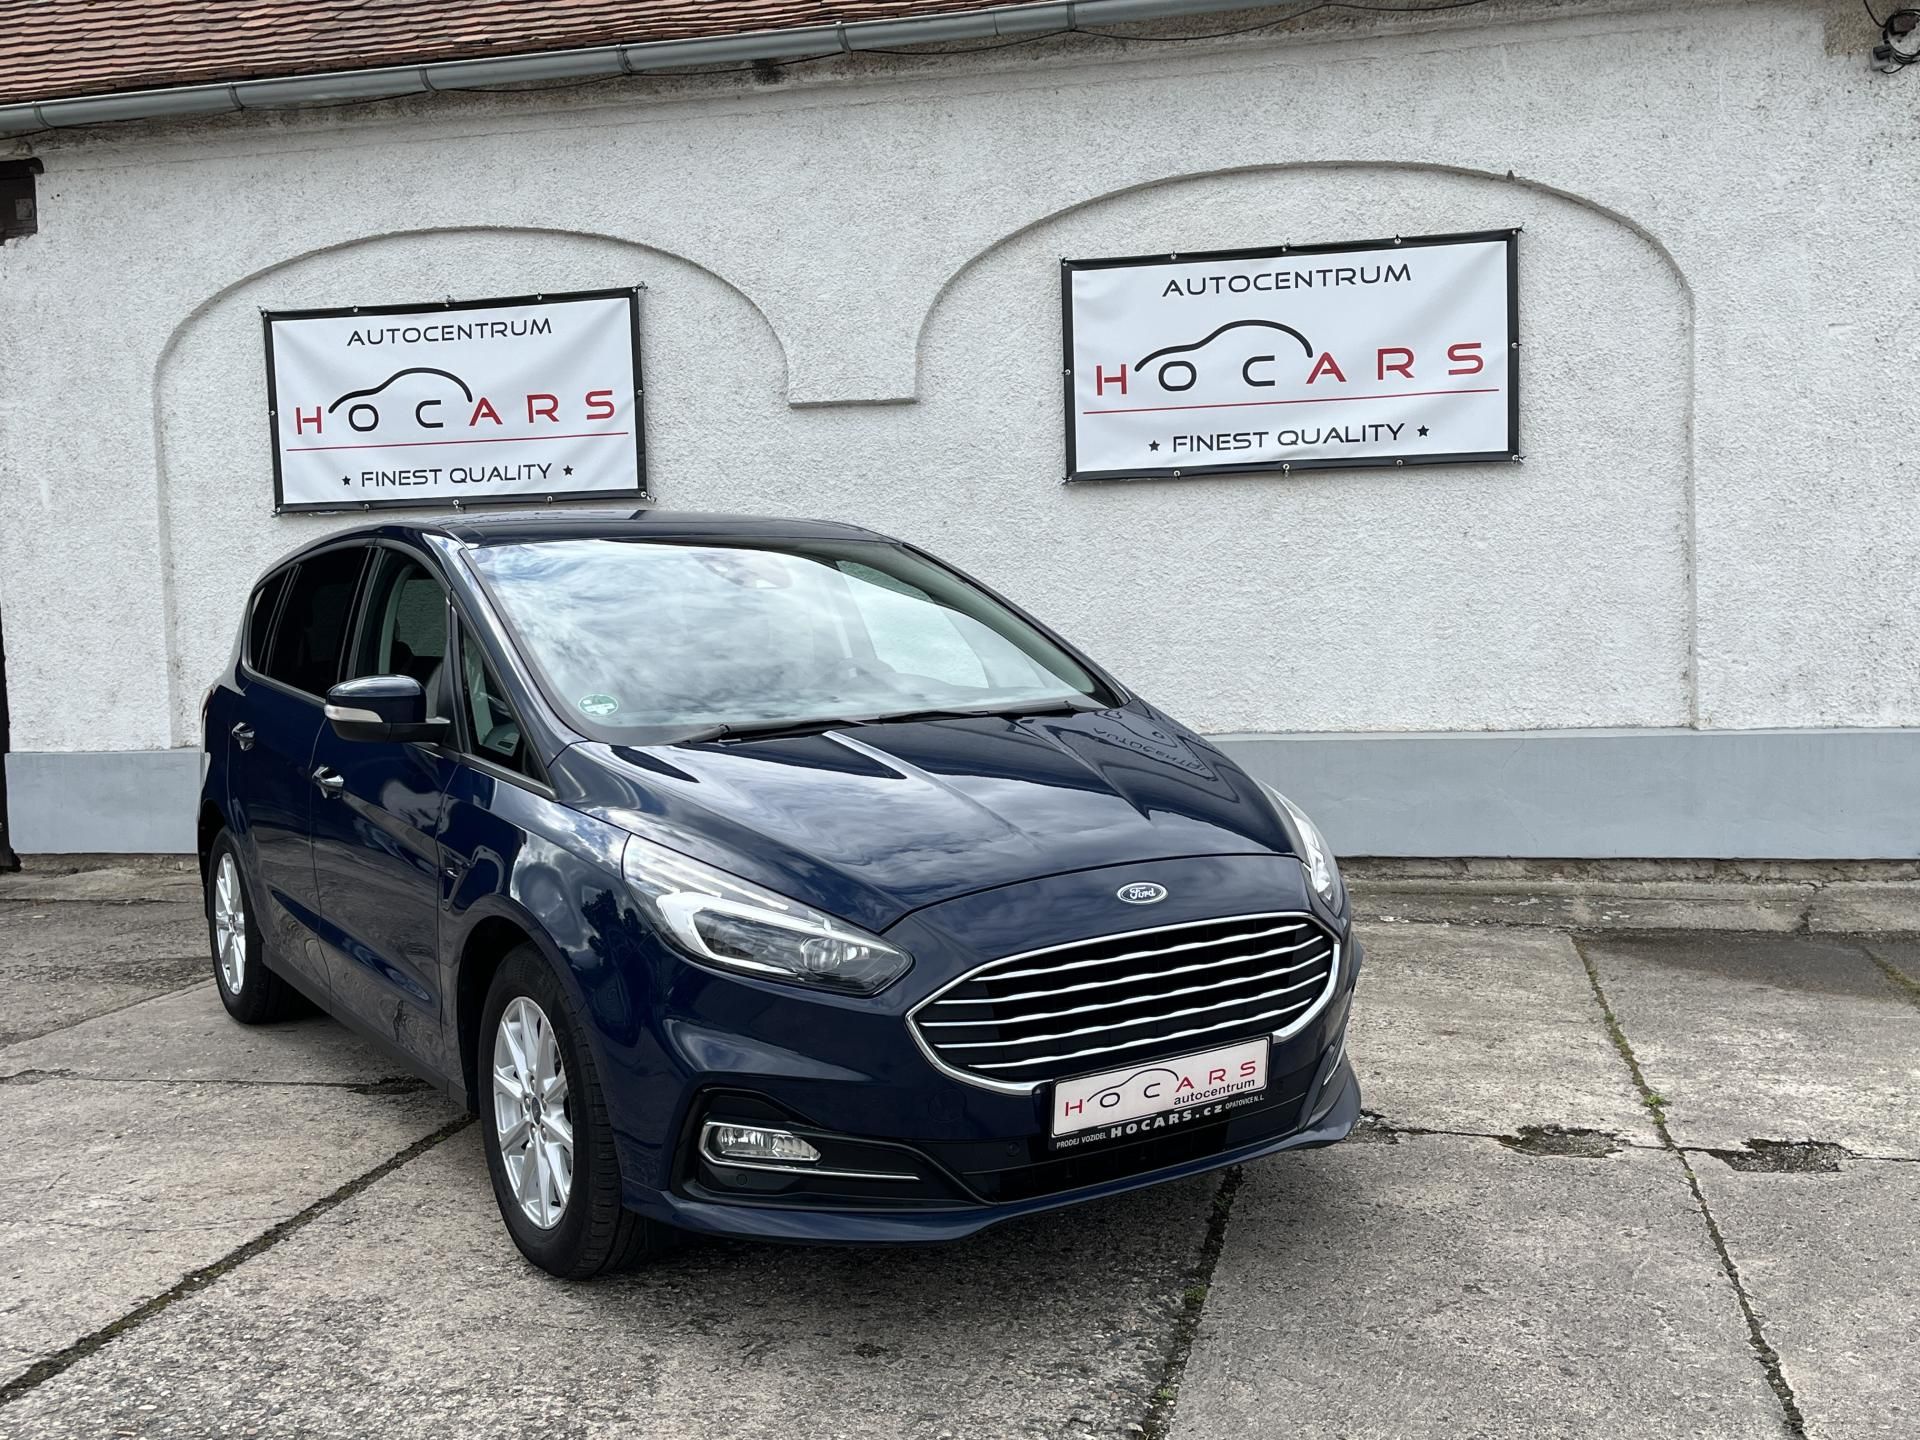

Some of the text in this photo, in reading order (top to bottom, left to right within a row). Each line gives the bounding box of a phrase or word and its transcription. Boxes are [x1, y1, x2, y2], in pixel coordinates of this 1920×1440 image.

[1162, 263, 1411, 297] AUTOCENTRUM
[346, 317, 552, 347] AUTOCENTRUM
[1096, 342, 1483, 396] HOCARS
[295, 389, 615, 435] HOCARS
[1173, 423, 1406, 453] FINEST QUALITY
[360, 463, 553, 488] FINEST QUALITY
[1129, 886, 1156, 900] Ford
[1065, 1060, 1256, 1117] HOCARS
[1173, 1078, 1255, 1106] autocentrum
[1056, 1138, 1080, 1150] PRODEJ
[1081, 1132, 1107, 1144] VOZIDEL
